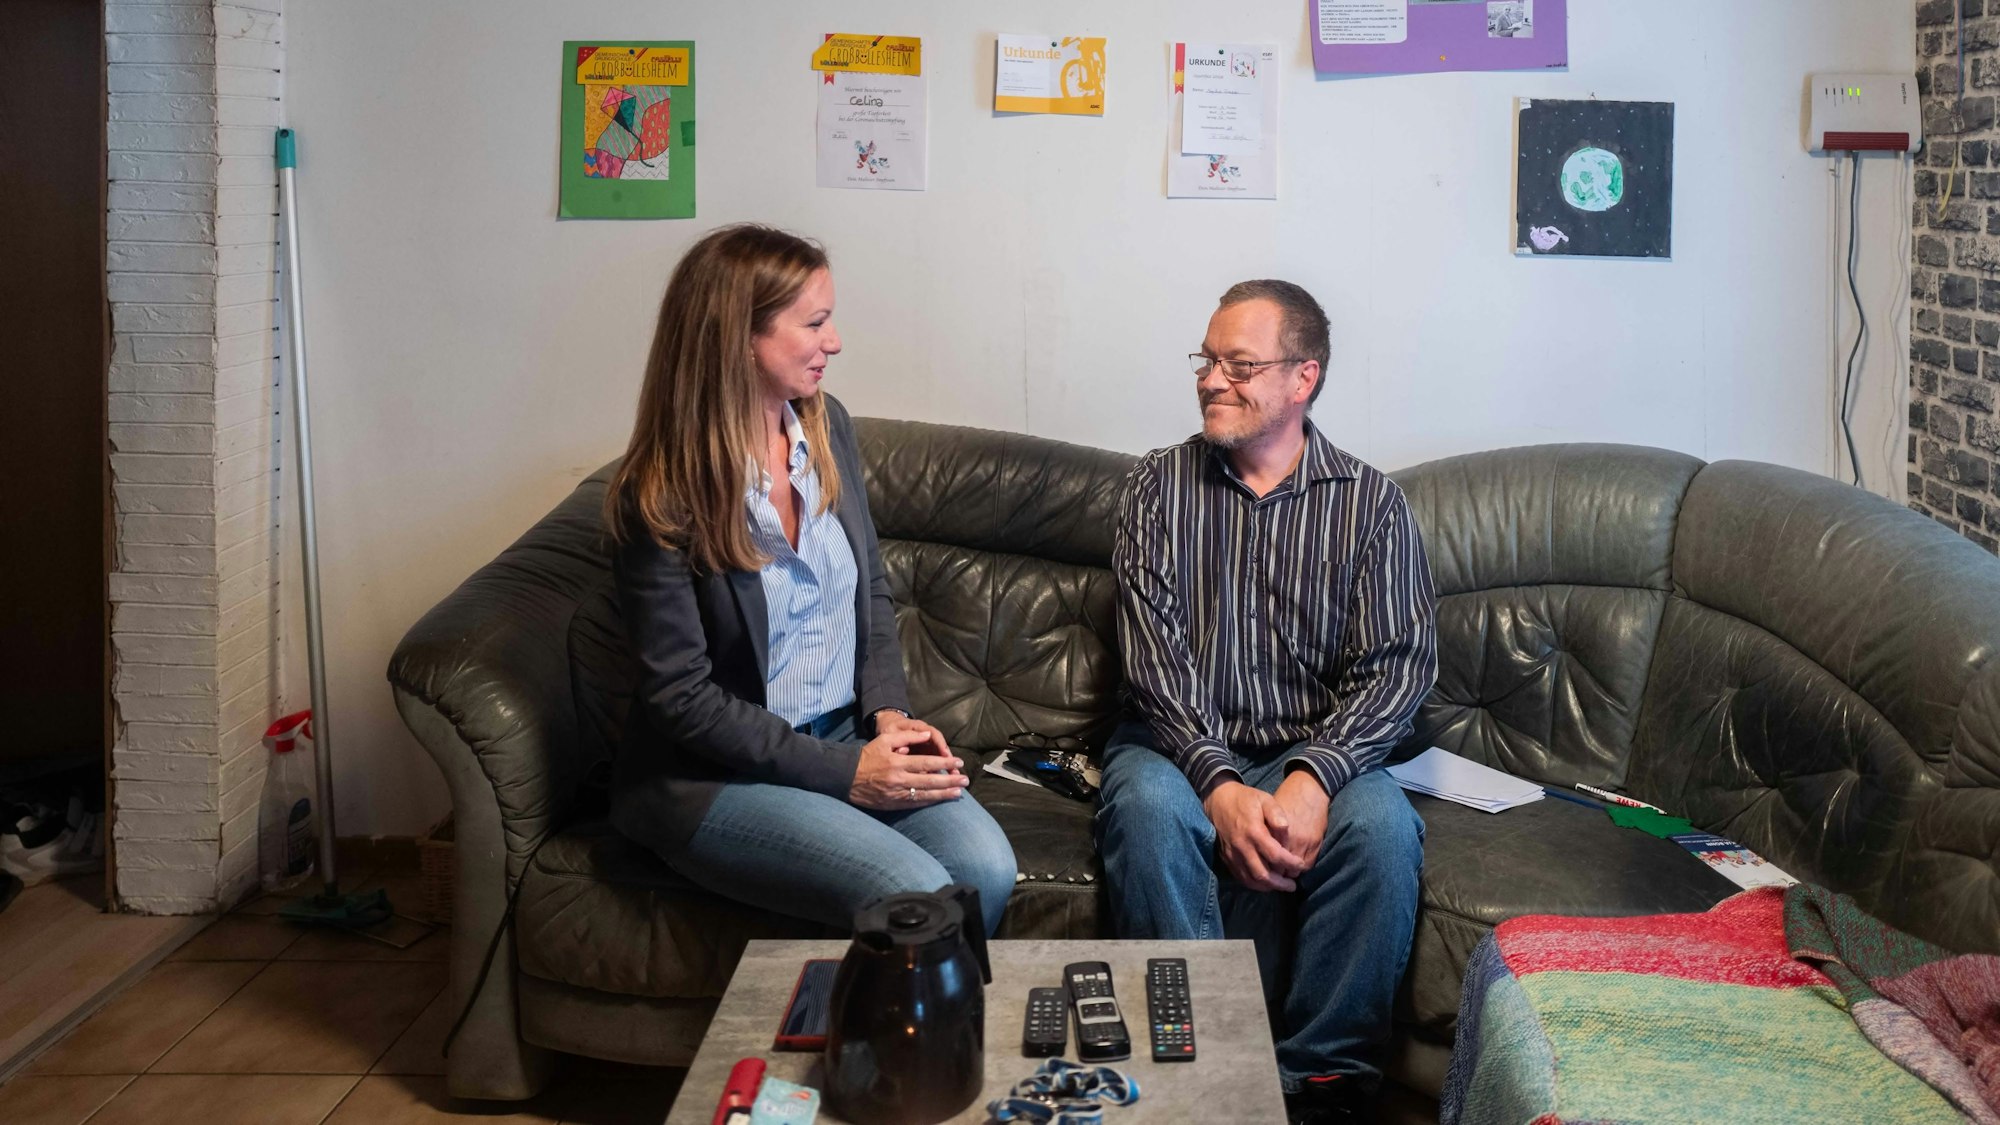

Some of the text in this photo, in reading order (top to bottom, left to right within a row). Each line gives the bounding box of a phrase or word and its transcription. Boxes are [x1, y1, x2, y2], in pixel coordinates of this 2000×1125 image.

[1003, 46, 1062, 60] Urkunde
[1189, 58, 1226, 67] URKUNDE
[849, 95, 884, 107] Celina
[1616, 797, 1641, 808] REWE
